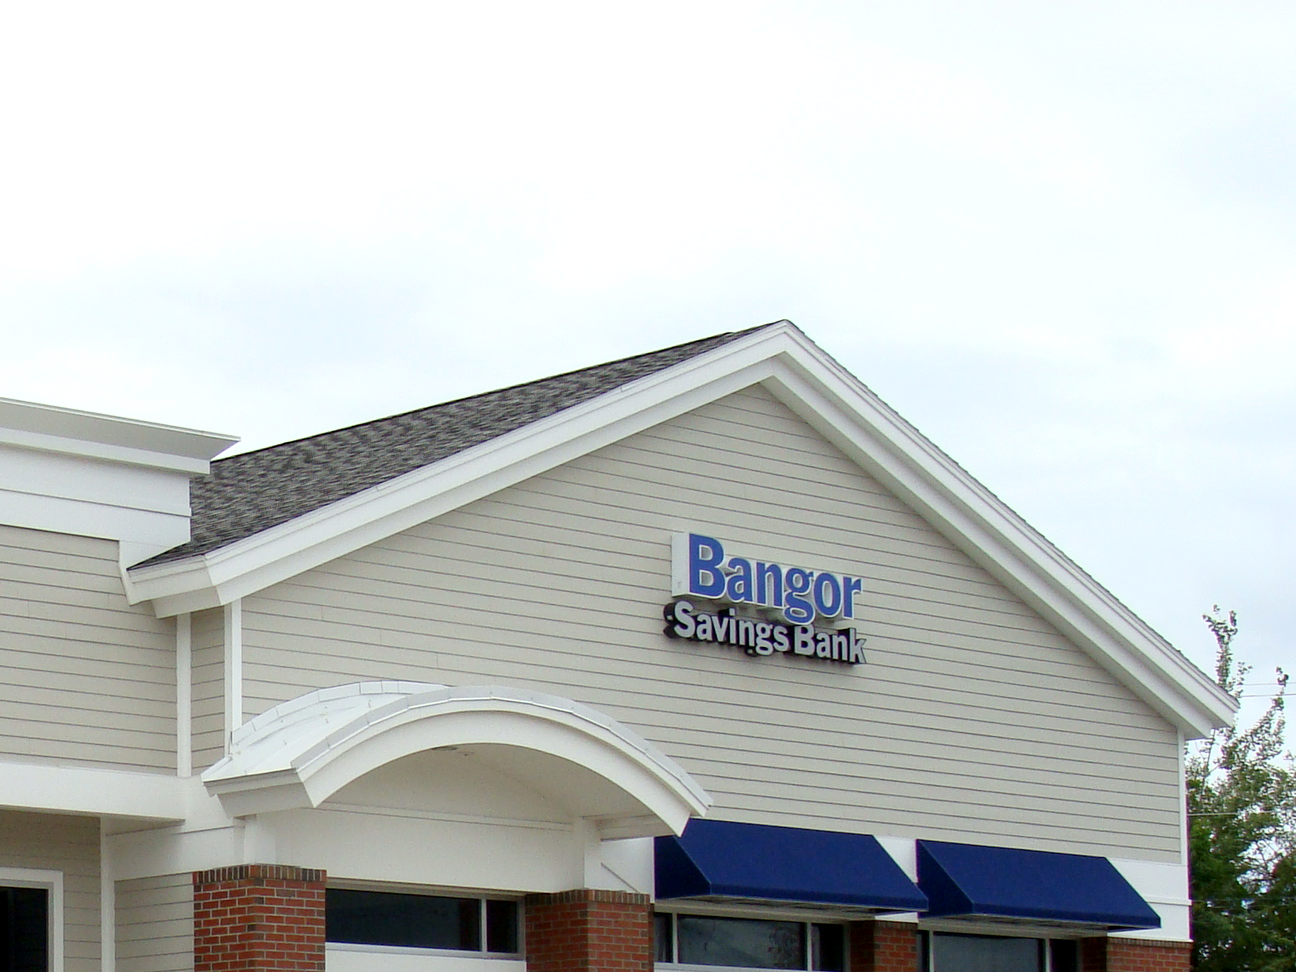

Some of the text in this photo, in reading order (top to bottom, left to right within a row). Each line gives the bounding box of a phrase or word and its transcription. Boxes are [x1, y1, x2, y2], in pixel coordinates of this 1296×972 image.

[687, 532, 863, 625] Bangor
[672, 600, 868, 664] Savings Bank
